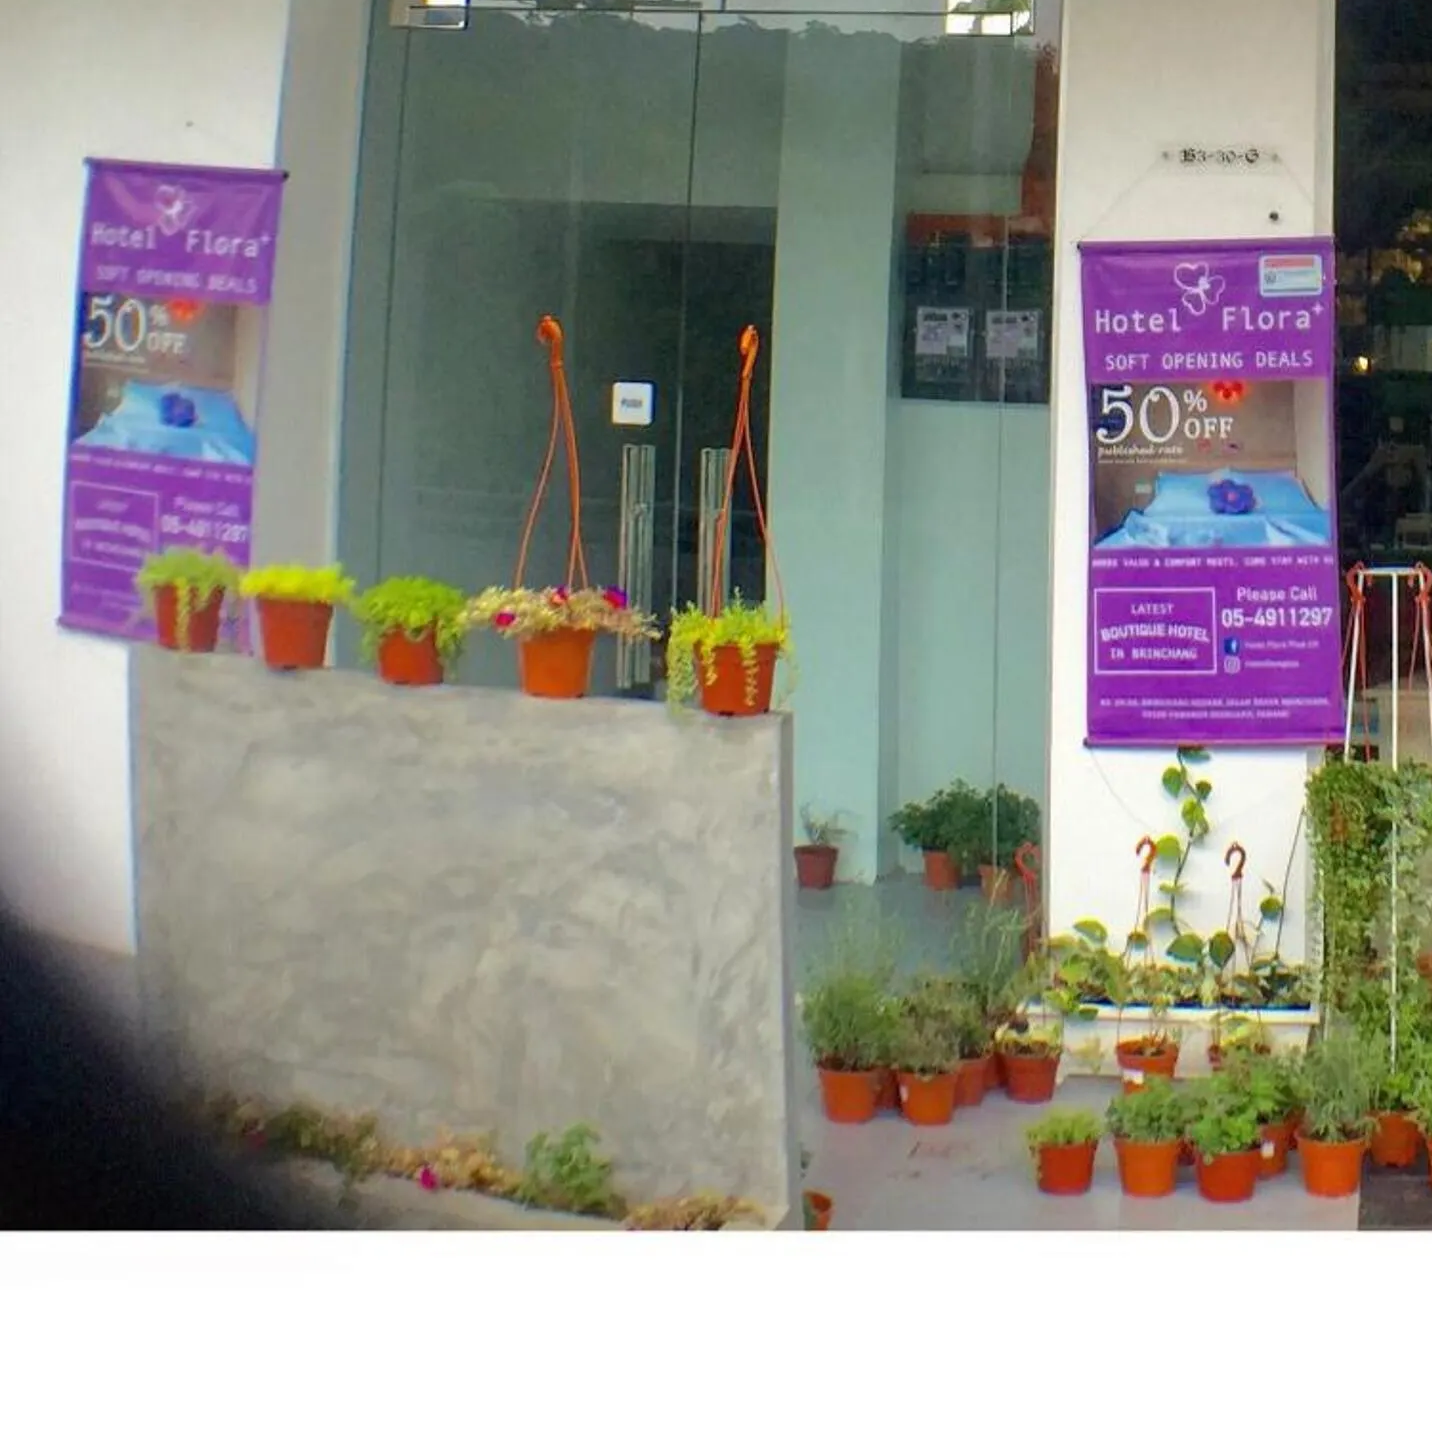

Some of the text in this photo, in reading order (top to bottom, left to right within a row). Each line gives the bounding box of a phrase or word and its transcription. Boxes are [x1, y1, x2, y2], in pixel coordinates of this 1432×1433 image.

[90, 222, 157, 250] Hotel
[1094, 308, 1182, 334] Hotel
[1104, 349, 1313, 371] SOFT OPENING DEALS
[1183, 416, 1234, 440] OFF
[1236, 584, 1318, 602] Please Call
[1130, 602, 1175, 616] LATEST
[1221, 607, 1333, 628] 05-4911297
[1101, 623, 1210, 645] BOUTIQUE HOTEL
[1131, 647, 1199, 660] BRINCHANG
